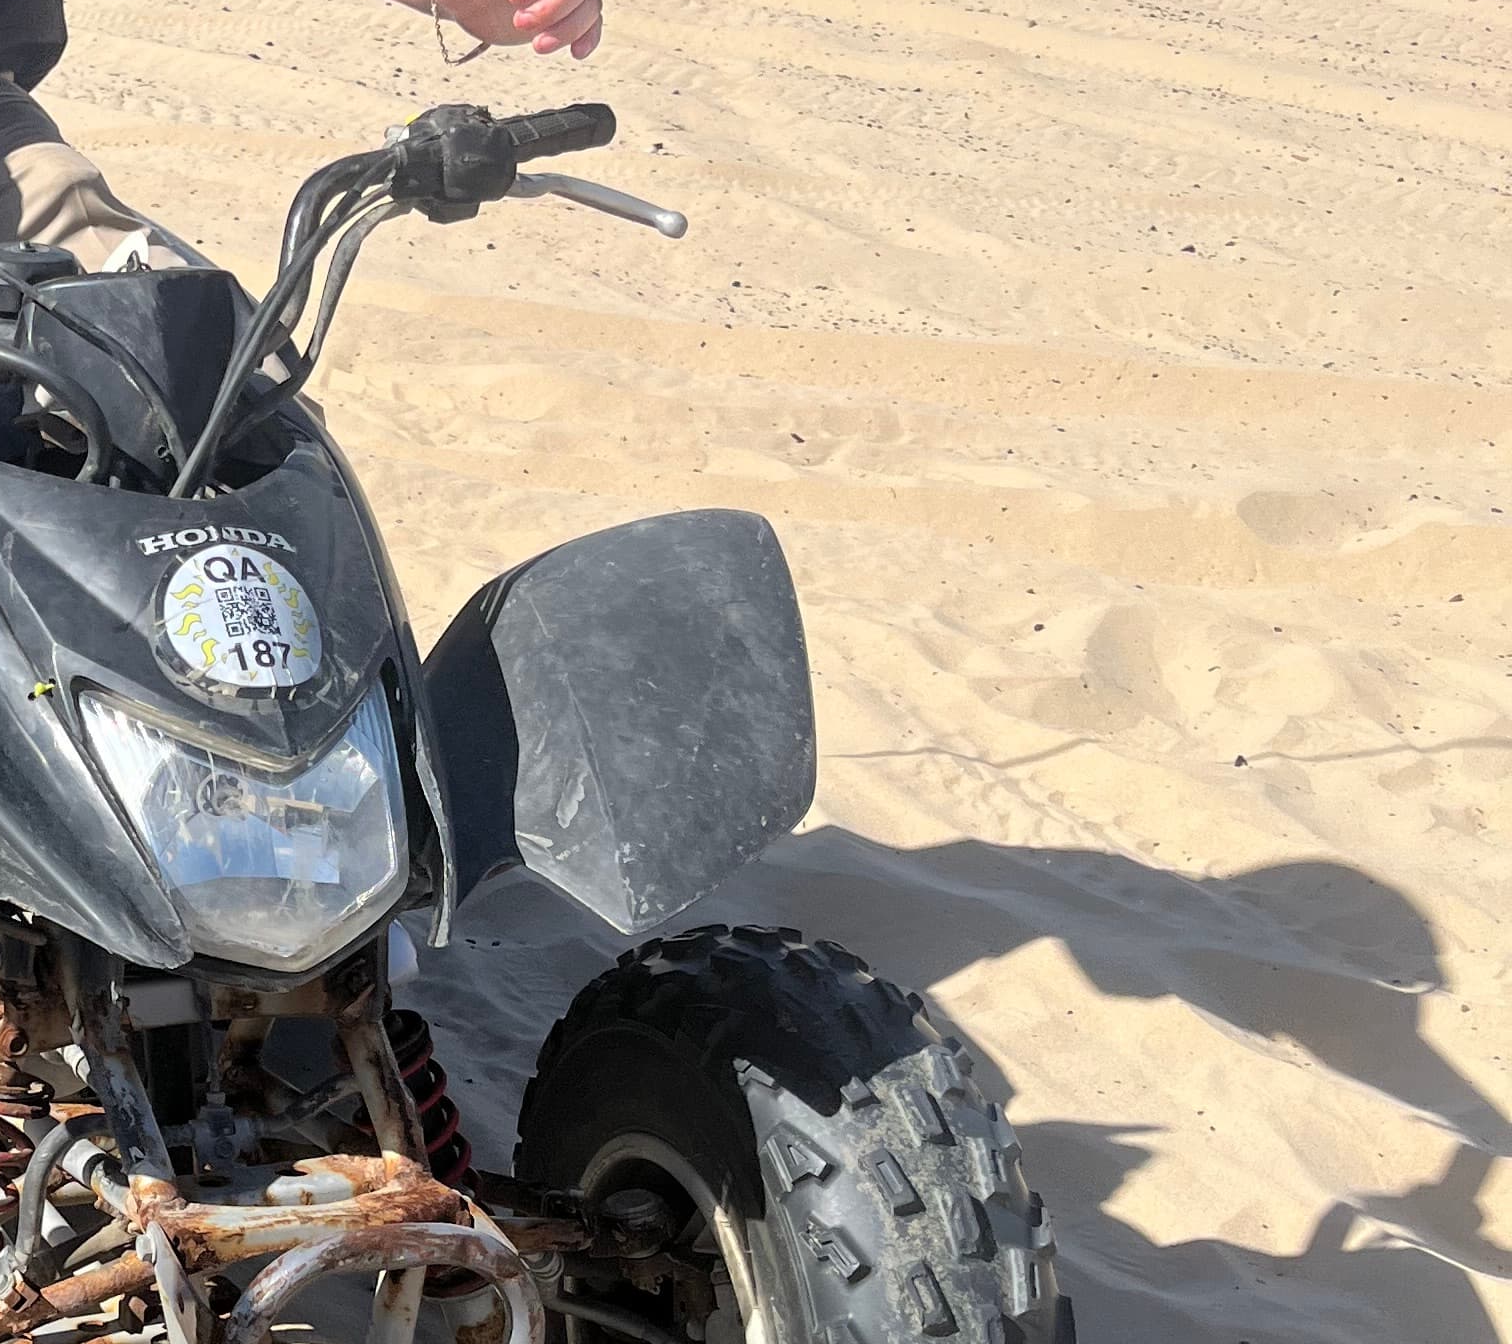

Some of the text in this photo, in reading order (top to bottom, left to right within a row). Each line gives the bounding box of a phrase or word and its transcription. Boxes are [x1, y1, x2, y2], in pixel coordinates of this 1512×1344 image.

[138, 525, 297, 556] HONDA
[203, 556, 266, 583] QA
[228, 639, 291, 671] 187
